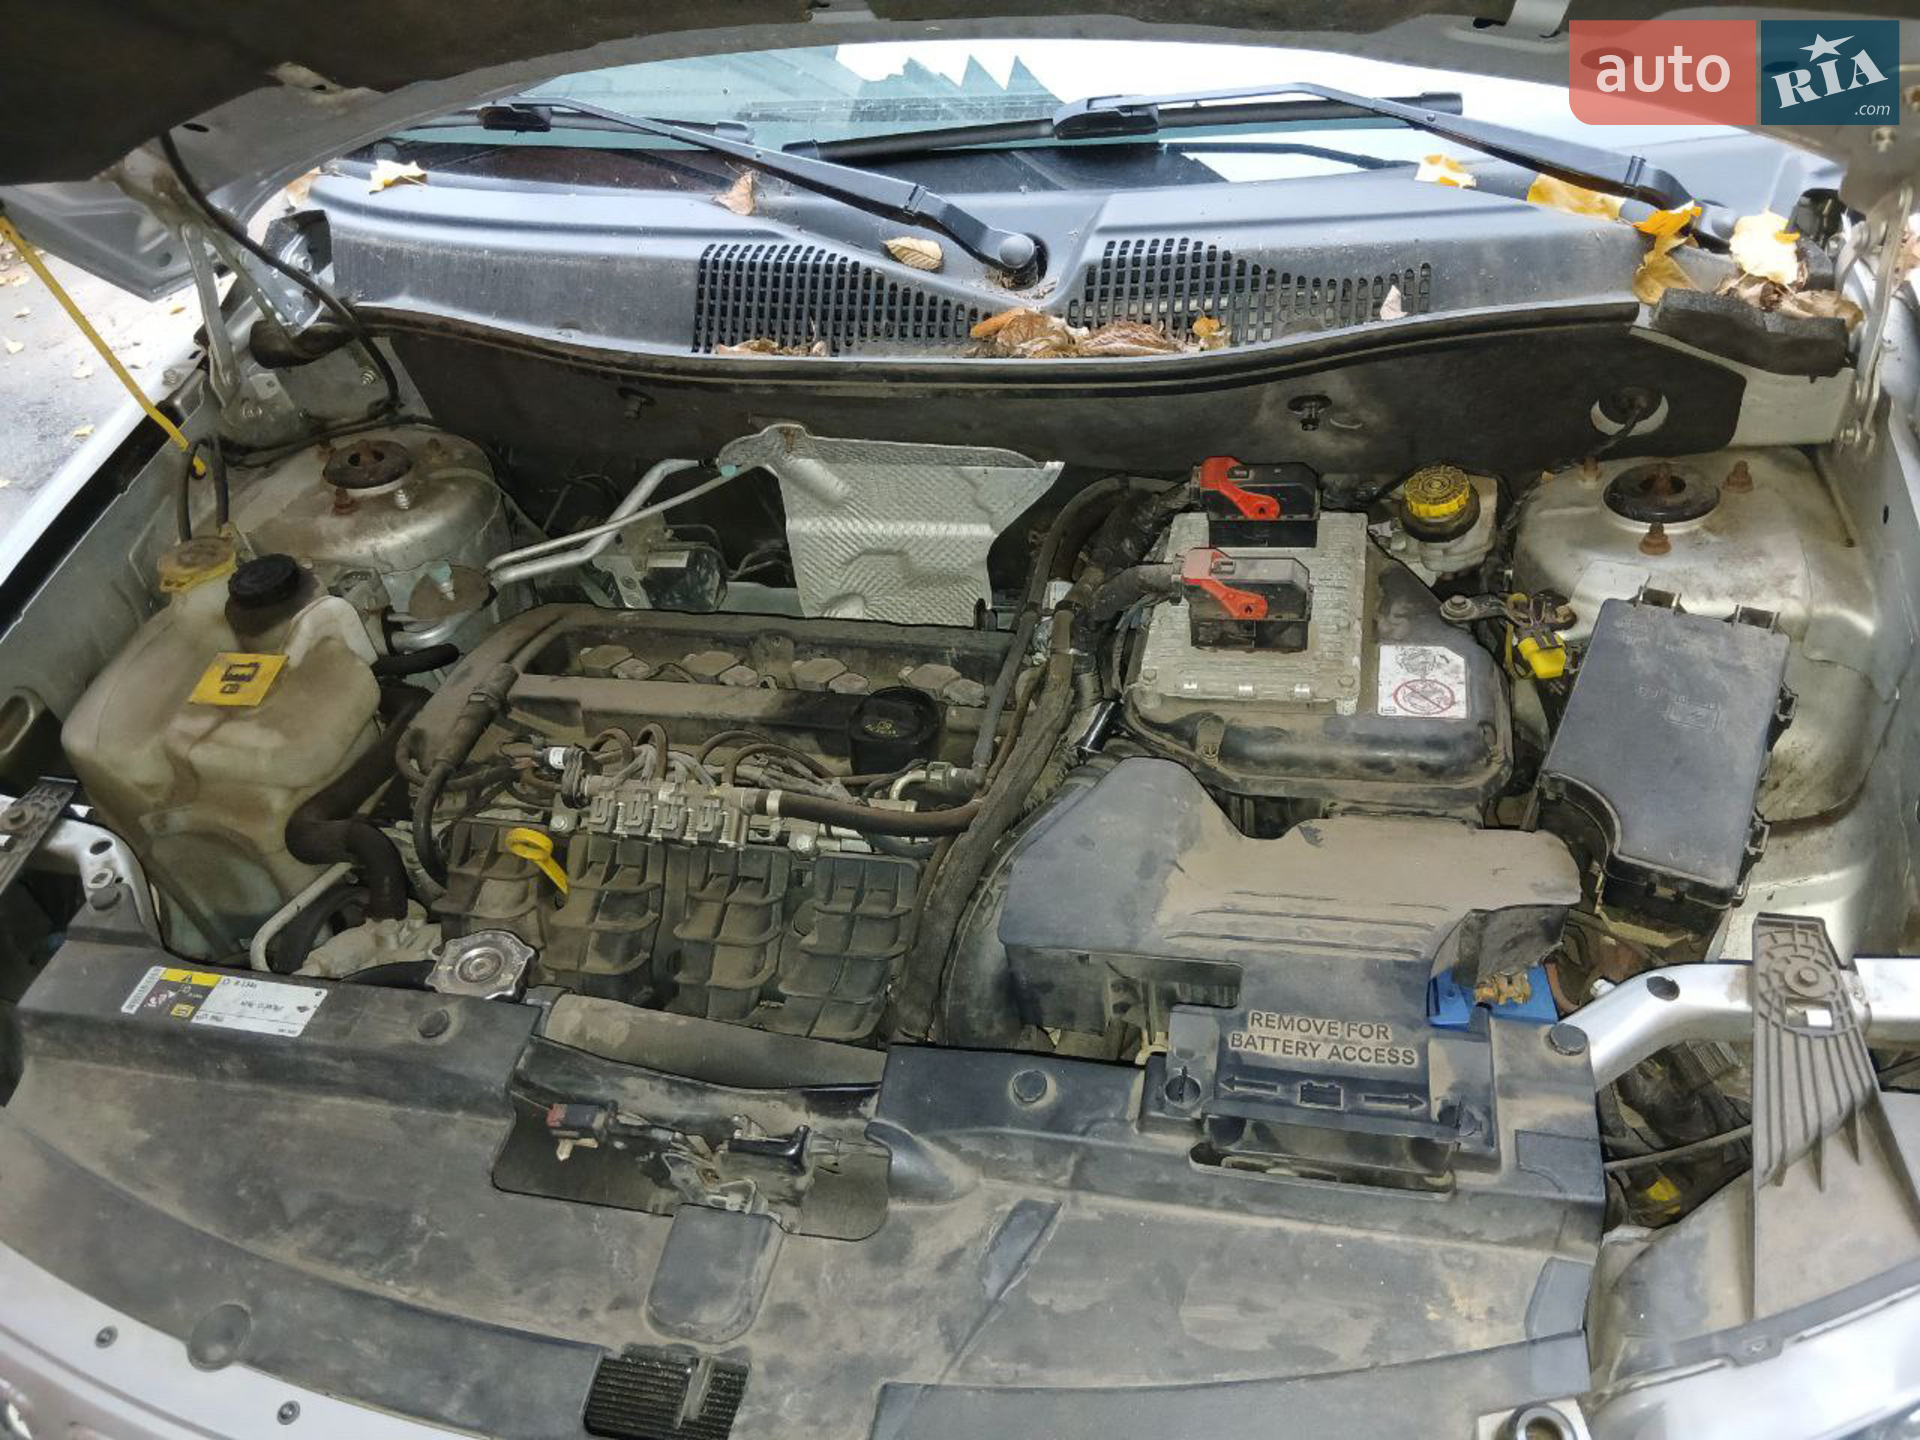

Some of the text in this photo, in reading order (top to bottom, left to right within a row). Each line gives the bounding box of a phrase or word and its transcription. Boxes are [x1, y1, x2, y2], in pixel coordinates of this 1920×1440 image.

[1250, 1011, 1390, 1040] REMOVE FOR
[1230, 1032, 1416, 1066] BATTERY ACCESS
